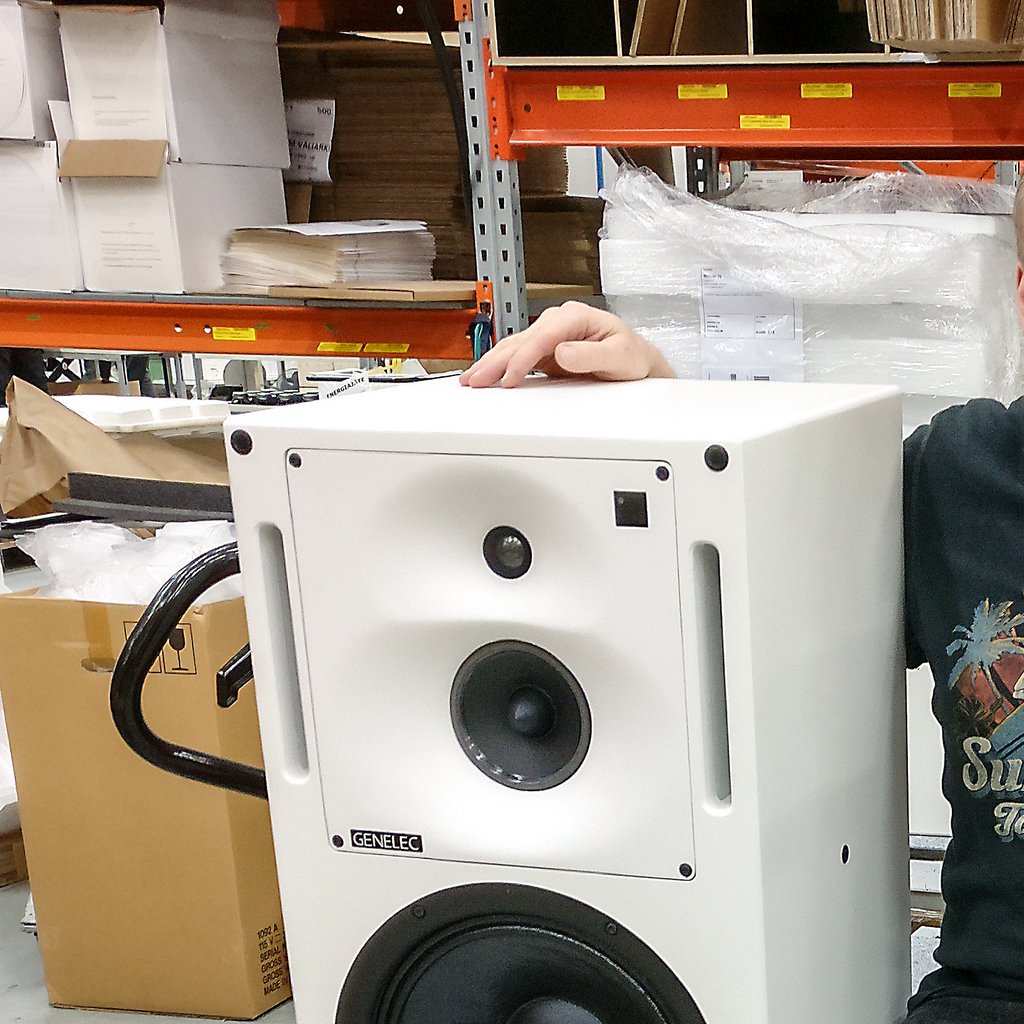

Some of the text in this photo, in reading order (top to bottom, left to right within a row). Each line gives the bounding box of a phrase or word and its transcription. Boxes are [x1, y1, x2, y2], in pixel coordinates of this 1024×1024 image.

[353, 832, 419, 850] GENELEC
[257, 923, 278, 939] 1092 A
[260, 946, 281, 962] SERIAL
[262, 957, 282, 973] GROSS
[262, 968, 283, 984] GROSS
[264, 980, 280, 995] MADE
